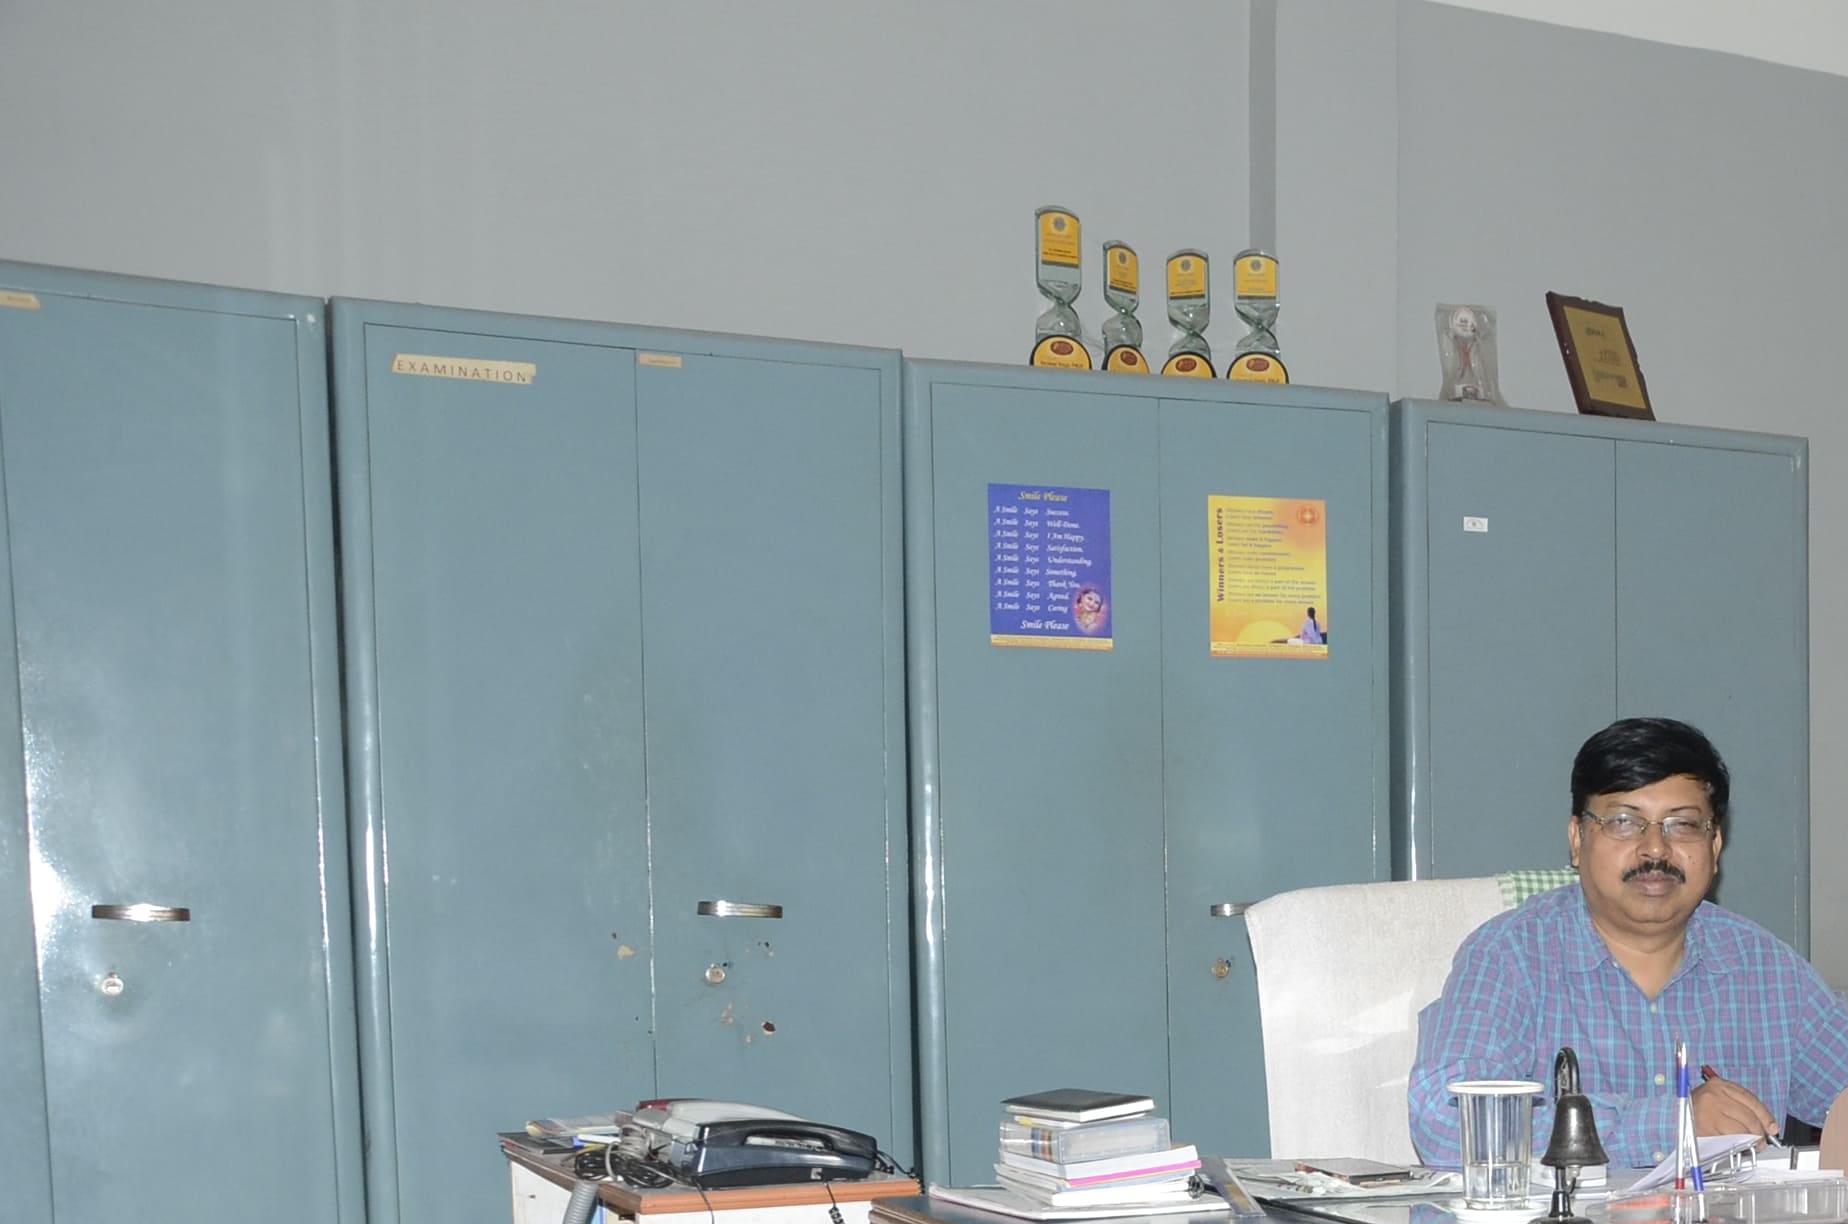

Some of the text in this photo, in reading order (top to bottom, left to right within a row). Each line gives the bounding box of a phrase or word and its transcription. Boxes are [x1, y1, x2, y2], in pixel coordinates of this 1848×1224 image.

[396, 359, 528, 382] EXAMINATION
[1018, 491, 1068, 502] Smile Please
[1002, 505, 1018, 513] Smile
[1024, 507, 1039, 516] Says
[1002, 518, 1018, 526] Smile
[1024, 519, 1039, 528] Says
[1216, 508, 1224, 544] Losers
[1002, 530, 1018, 538] Smile
[1024, 531, 1039, 540] Says
[1002, 542, 1019, 550] Smile
[1025, 544, 1039, 553] Says
[1003, 554, 1019, 562] Smile
[1025, 556, 1039, 564] Says
[1003, 566, 1019, 574] Smile
[1025, 568, 1039, 577] Says
[1003, 578, 1019, 586] Smile
[1025, 580, 1040, 588] Says
[1216, 556, 1224, 602] Winners
[1003, 590, 1020, 598] Smile
[1025, 592, 1040, 600] Says
[1003, 602, 1020, 610] Smile
[1025, 604, 1040, 613] Says
[1020, 620, 1069, 630] Smile Please
